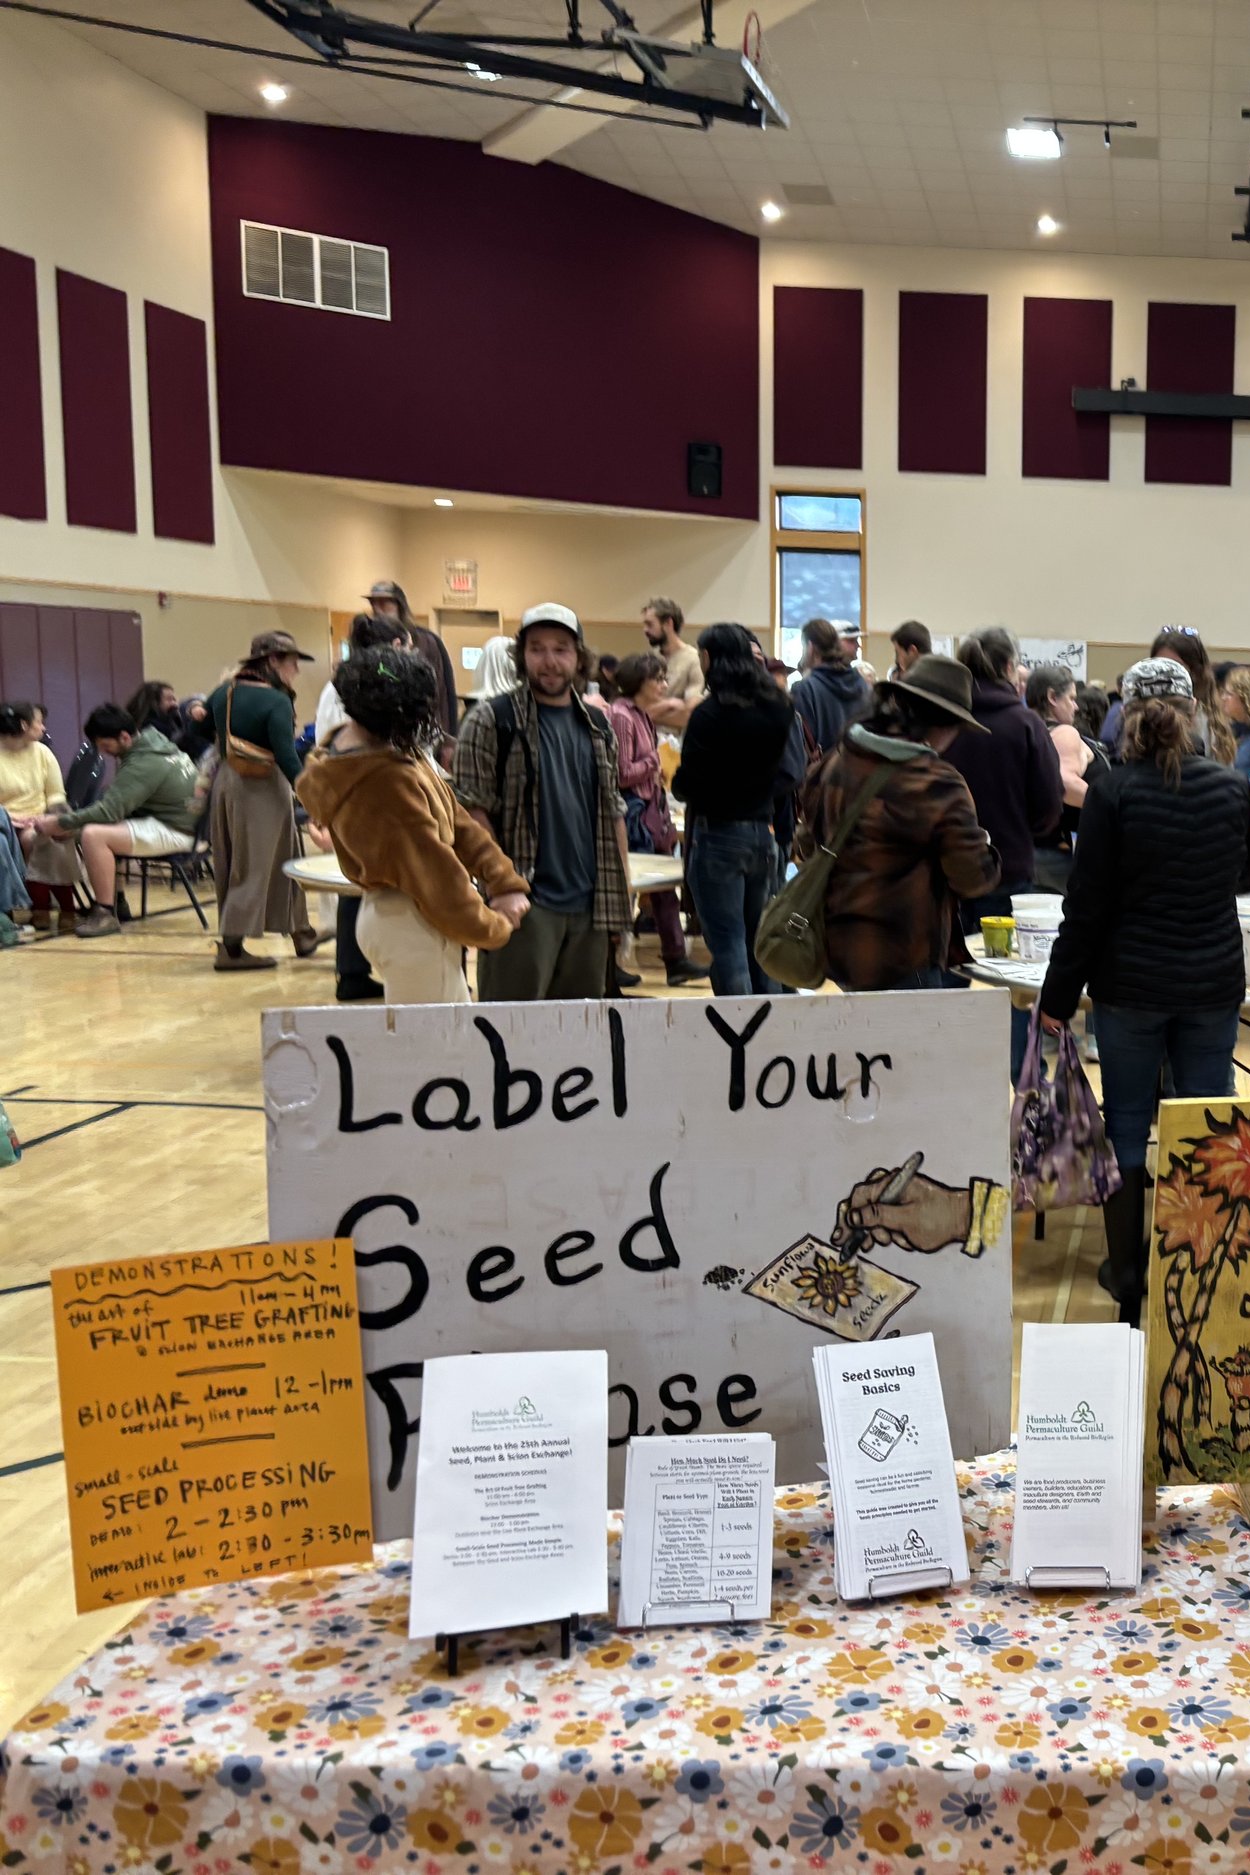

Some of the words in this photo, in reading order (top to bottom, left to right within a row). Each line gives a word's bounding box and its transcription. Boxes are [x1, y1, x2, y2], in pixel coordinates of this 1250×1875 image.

[326, 1007, 627, 1132] Label
[705, 1000, 893, 1112] Your
[334, 1161, 680, 1330] Seed
[98, 1303, 125, 1322] art
[133, 1300, 153, 1315] of
[183, 1312, 244, 1335] TREE
[292, 1328, 335, 1342] AREA
[842, 1368, 871, 1383] Seed
[873, 1365, 916, 1379] Saving
[862, 1382, 901, 1396] Basics
[185, 1413, 204, 1433] by
[209, 1406, 231, 1424] live
[237, 1405, 277, 1423] plant
[1026, 1414, 1067, 1424] Humboldt
[1026, 1424, 1079, 1433] Permaculture
[1079, 1423, 1104, 1432] Guild
[451, 1443, 492, 1454] Welcome
[493, 1443, 503, 1451] to
[504, 1442, 519, 1450] the
[540, 1437, 571, 1447] Annual
[474, 1454, 496, 1463] Plant
[498, 1454, 505, 1462] &
[102, 1486, 168, 1520] SEED
[165, 1516, 187, 1541] 2
[734, 1522, 752, 1531] seeds
[732, 1551, 751, 1560] seeds
[864, 1552, 911, 1566] Permaculture
[912, 1547, 934, 1558] Guild
[736, 1568, 753, 1576] seeds
